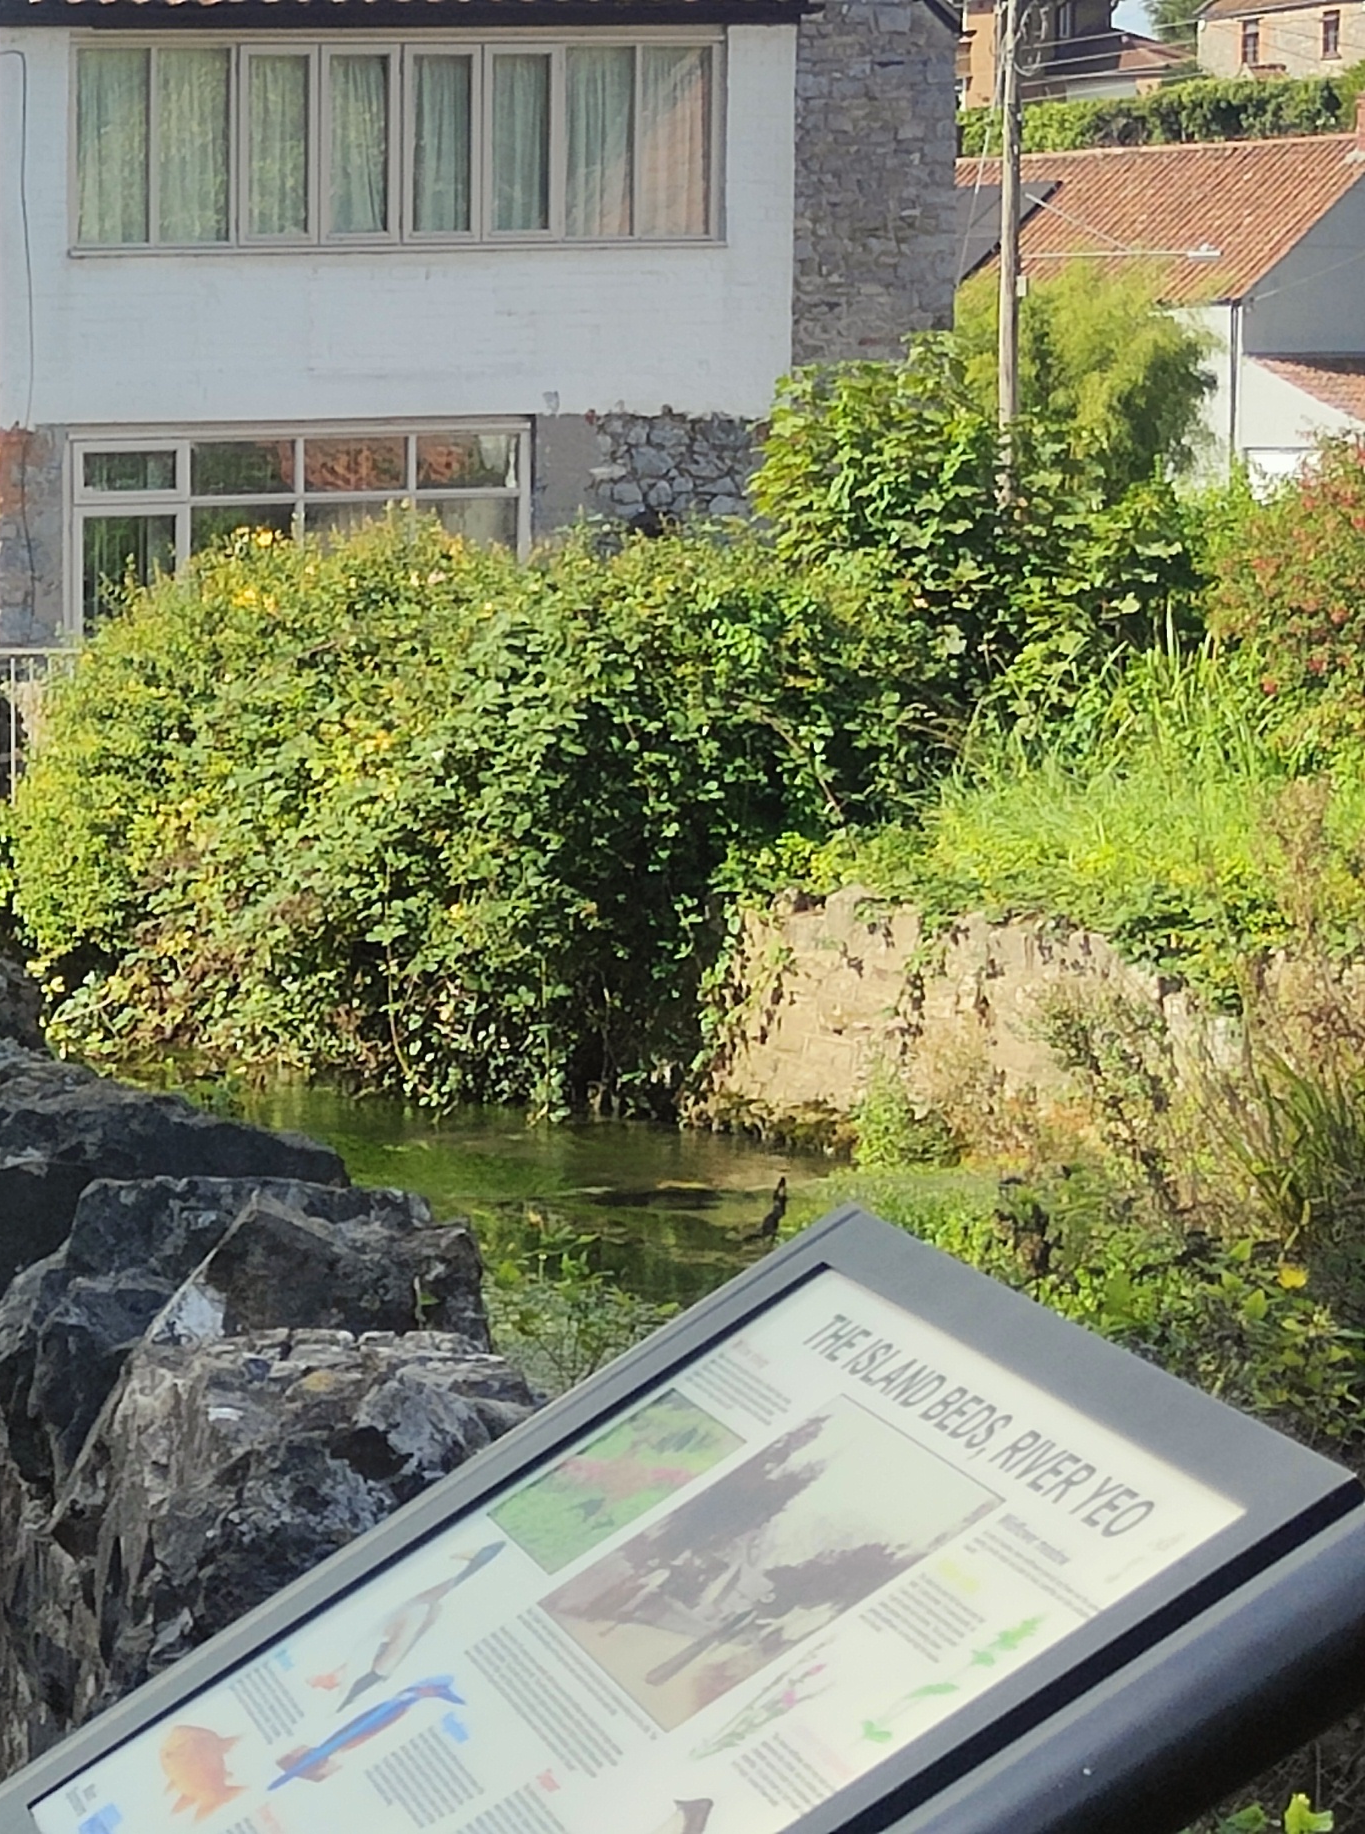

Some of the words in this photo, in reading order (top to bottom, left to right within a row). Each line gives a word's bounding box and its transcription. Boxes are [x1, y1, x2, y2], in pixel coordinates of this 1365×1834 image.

[802, 1313, 871, 1363] THE
[841, 1337, 947, 1409] ISLAND
[919, 1386, 1013, 1460] BEDS,
[988, 1429, 1098, 1504] RIVER
[1068, 1475, 1155, 1538] YEO
